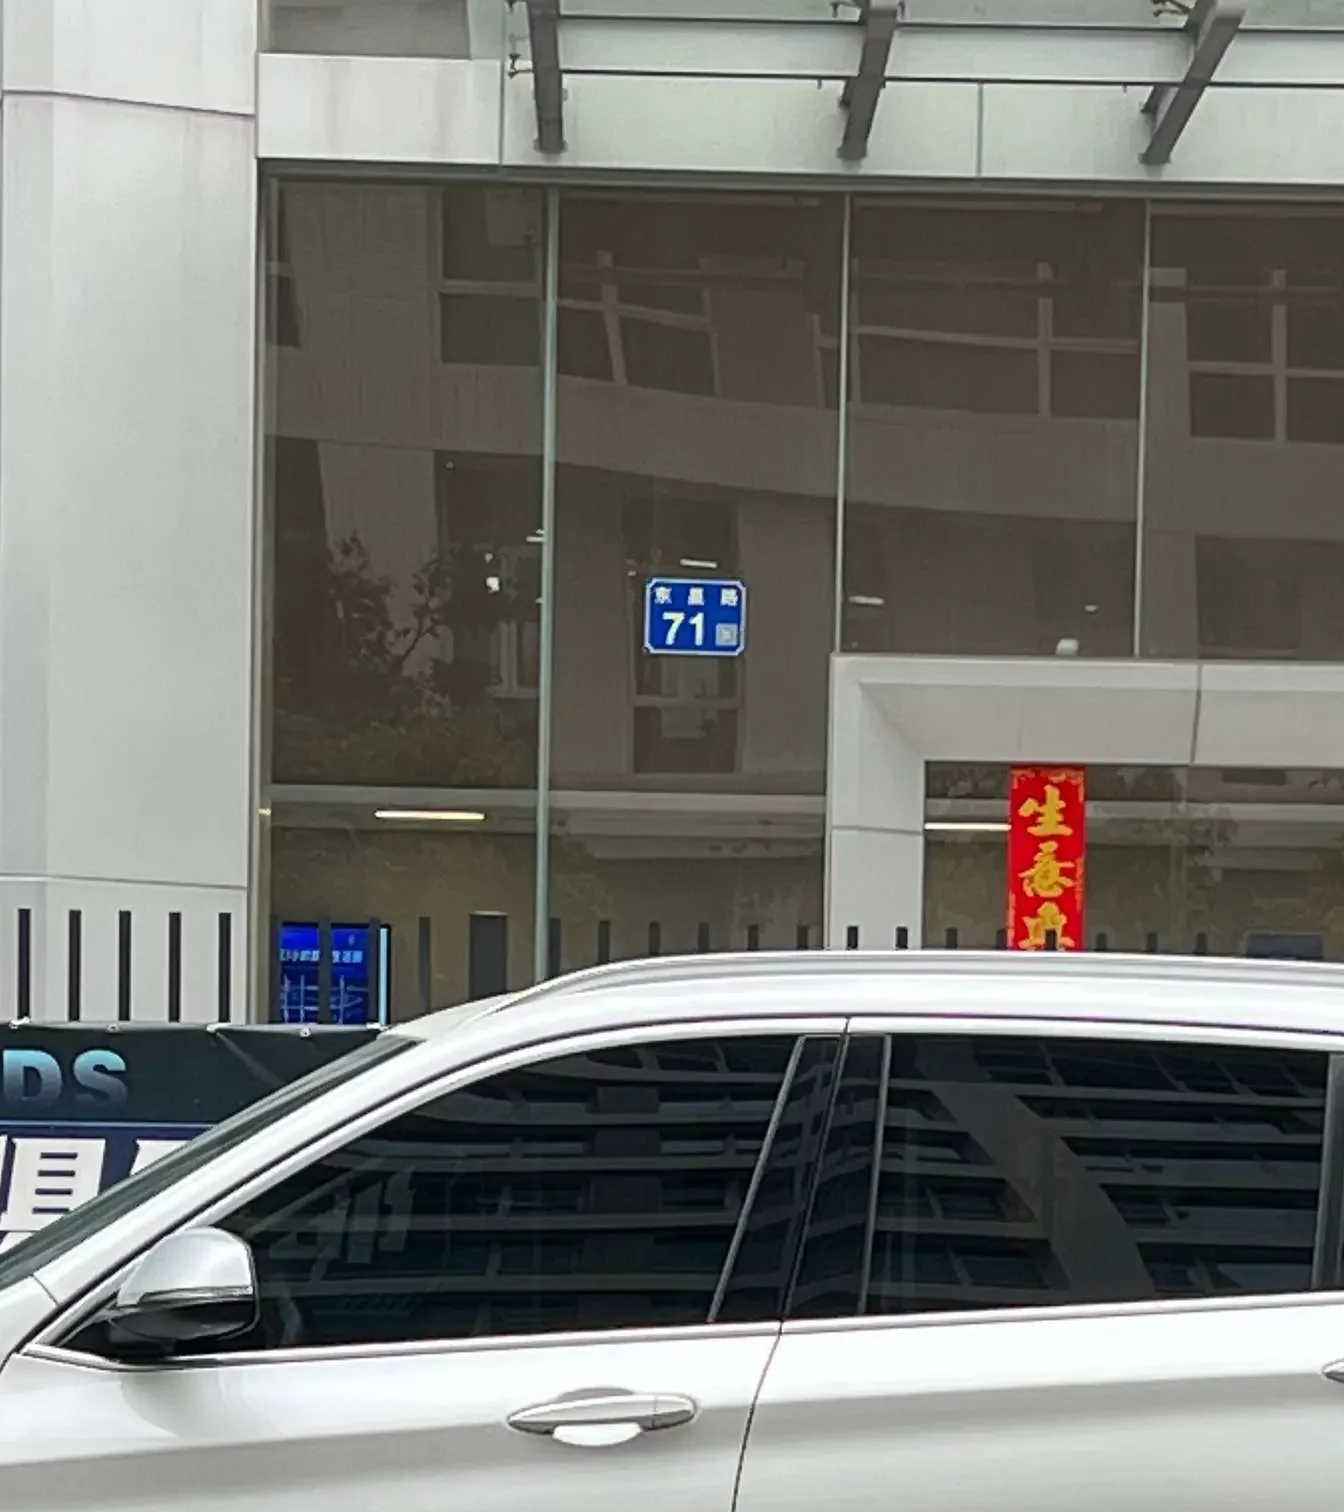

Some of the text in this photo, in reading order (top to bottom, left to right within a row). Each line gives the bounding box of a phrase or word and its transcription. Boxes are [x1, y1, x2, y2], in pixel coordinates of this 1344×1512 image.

[661, 611, 705, 647] 71
[1017, 784, 1076, 949] 生意興
